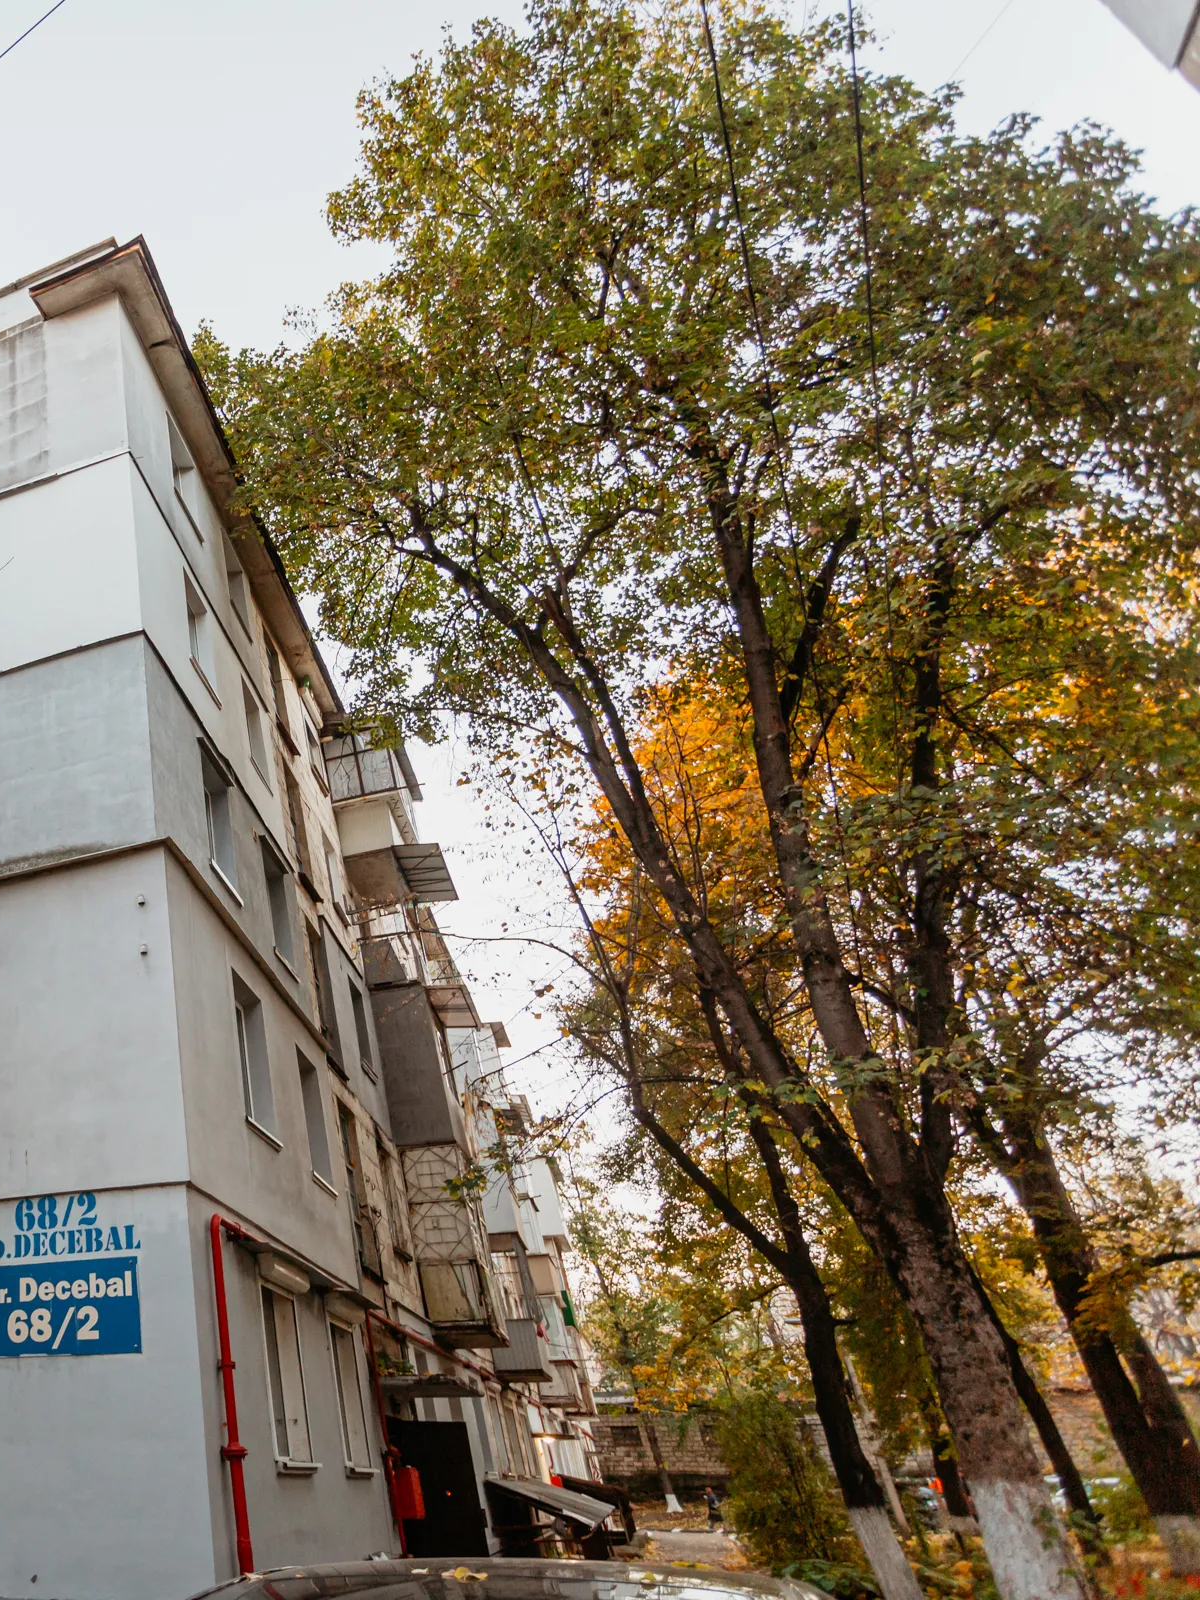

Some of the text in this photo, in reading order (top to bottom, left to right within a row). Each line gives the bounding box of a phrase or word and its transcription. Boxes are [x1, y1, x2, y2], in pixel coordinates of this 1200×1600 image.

[14, 1191, 98, 1232] 68/2
[19, 1270, 133, 1302] Decebal
[7, 1305, 100, 1350] 68/2
